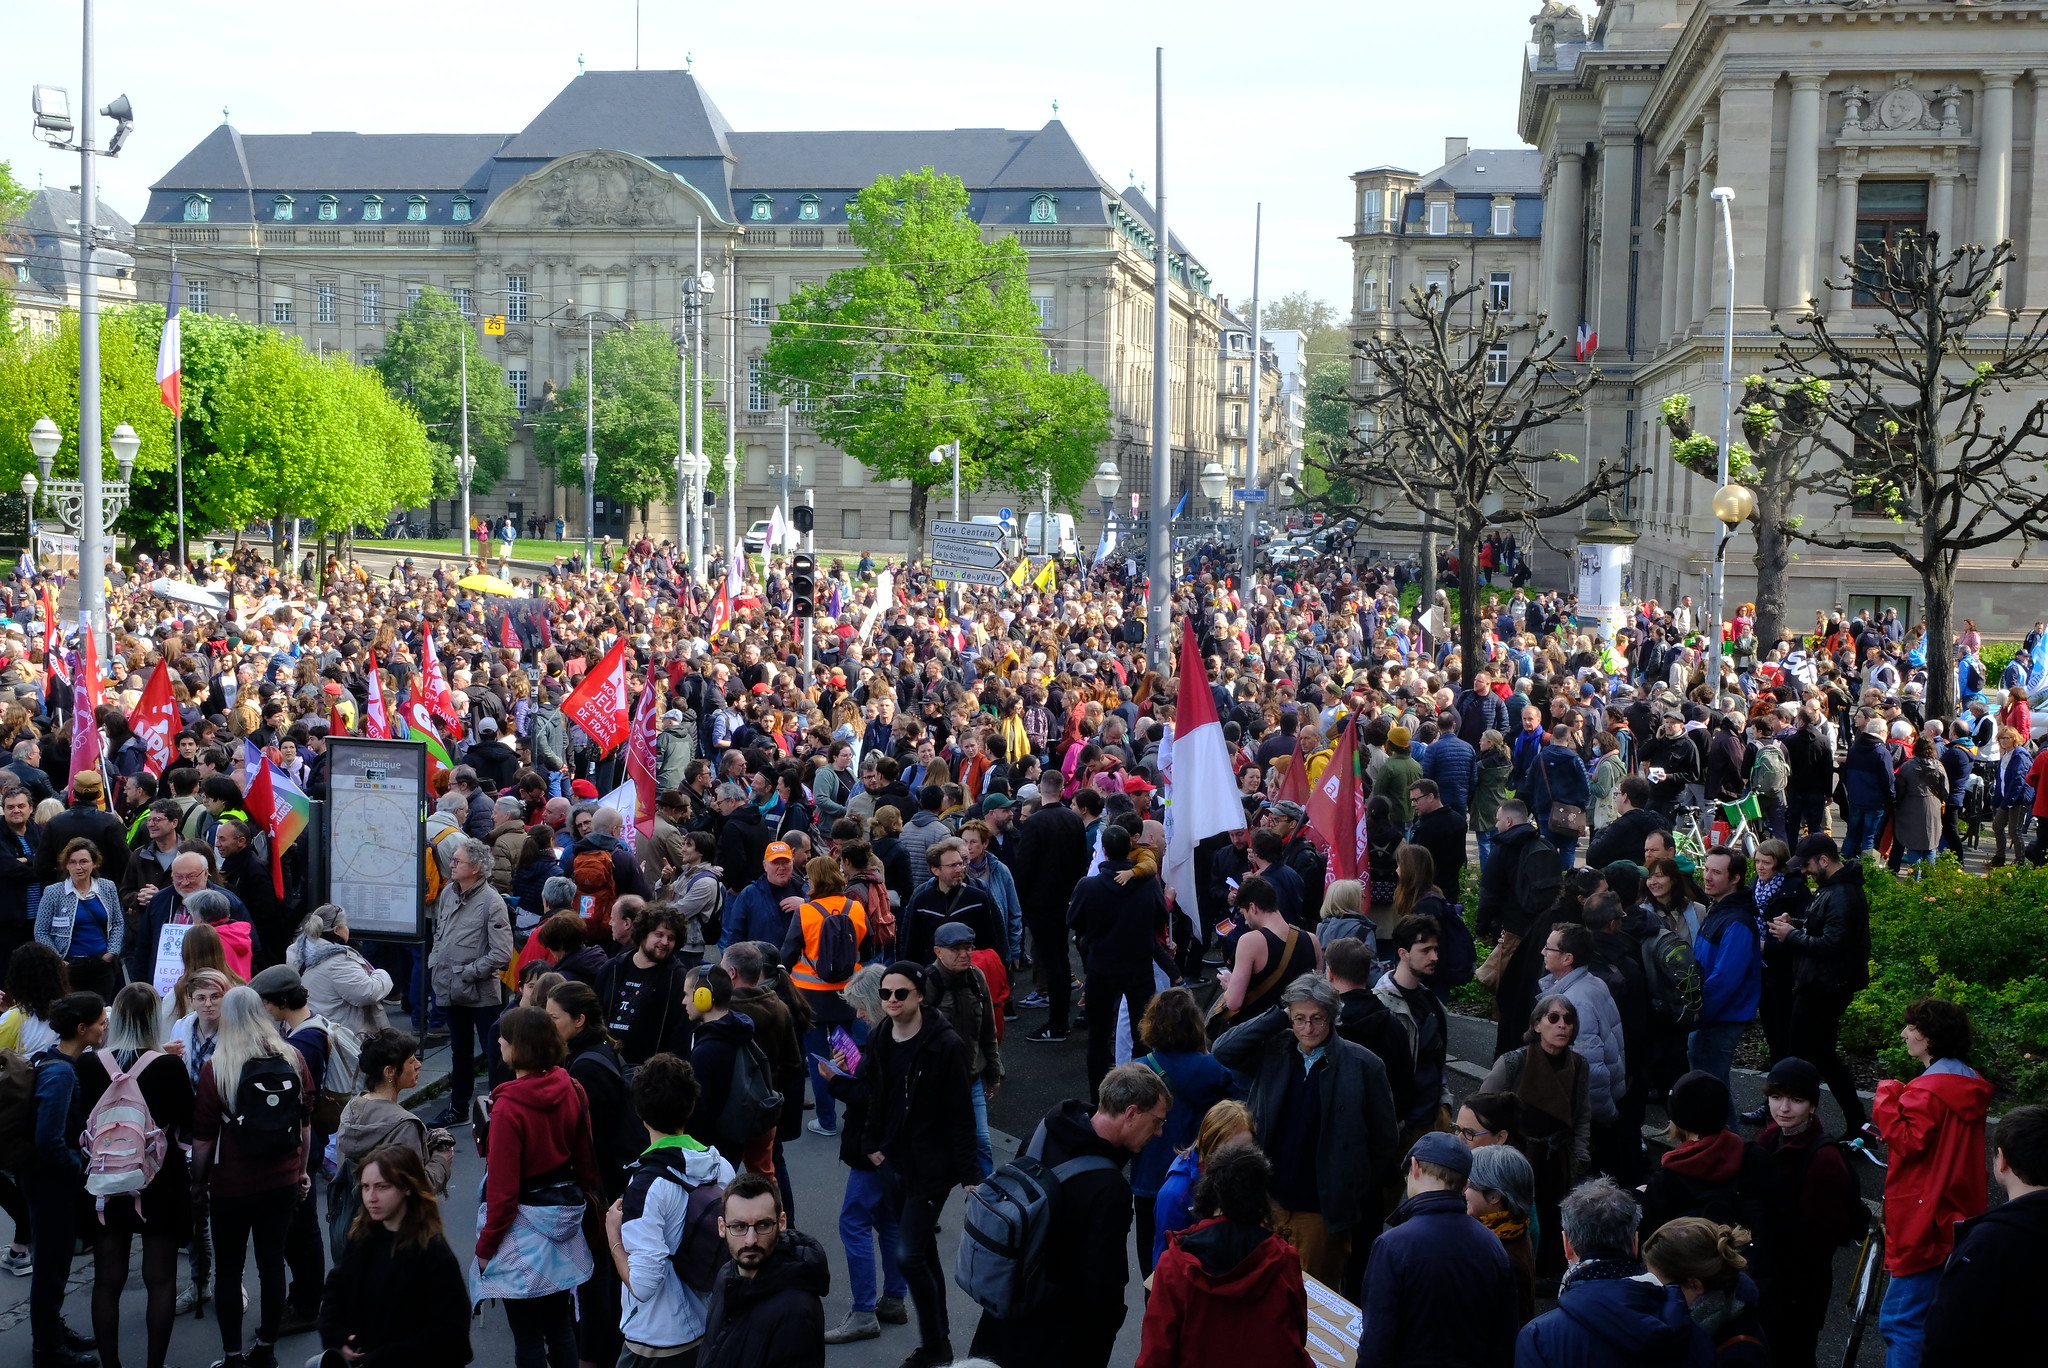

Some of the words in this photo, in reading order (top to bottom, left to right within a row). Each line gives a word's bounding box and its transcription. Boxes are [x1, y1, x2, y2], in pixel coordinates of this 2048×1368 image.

[488, 319, 501, 330] 25
[934, 524, 957, 535] Poste
[960, 526, 995, 538] Centrale
[936, 542, 962, 552] Fondation
[962, 546, 994, 558] Européenne
[961, 570, 973, 579] de
[432, 702, 458, 730] FRANCE
[576, 707, 590, 721] DE
[133, 720, 170, 771] NPA
[350, 758, 402, 770] République
[1337, 1299, 1355, 1314] RICHES
[1307, 1311, 1331, 1330] EPENSES
[1314, 1338, 1339, 1358] SOCIAUX
